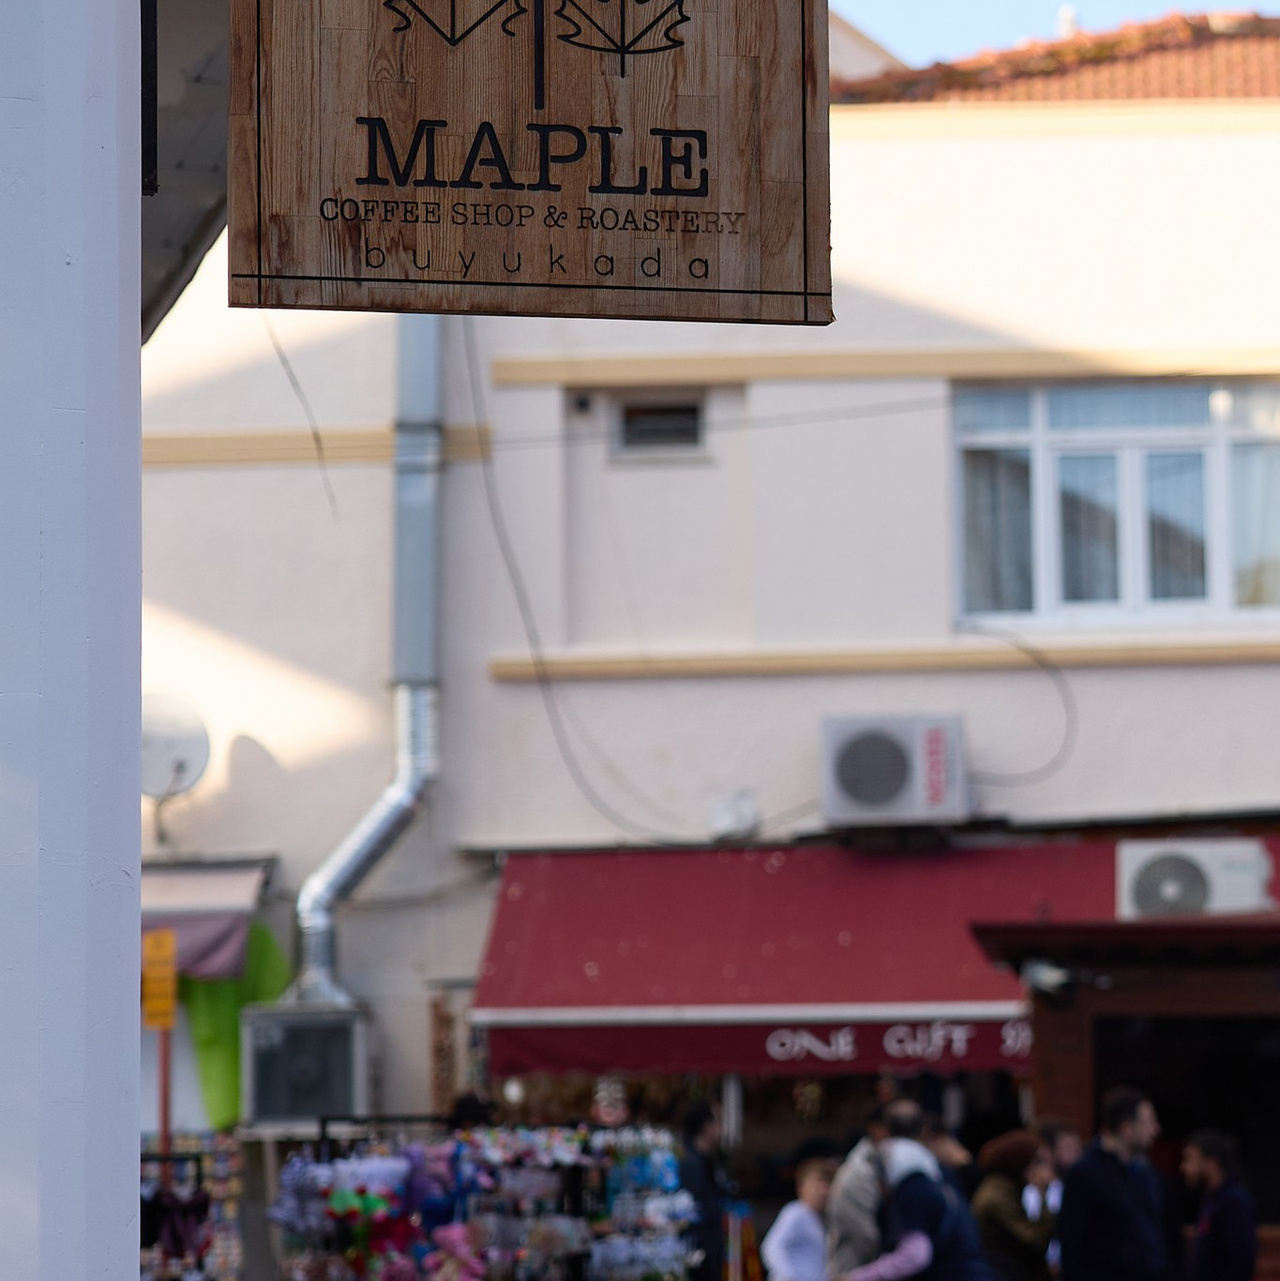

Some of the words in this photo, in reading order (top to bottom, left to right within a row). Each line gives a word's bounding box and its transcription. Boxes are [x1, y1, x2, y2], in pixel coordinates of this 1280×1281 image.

[355, 116, 709, 198] MAPLE
[319, 197, 441, 225] COFFEE
[451, 202, 535, 228] SHOP
[542, 204, 568, 229] &
[576, 206, 746, 235] ROASTERY
[364, 237, 709, 280] buyukada
[765, 1026, 857, 1062] ONE
[883, 1020, 977, 1062] GIFT
